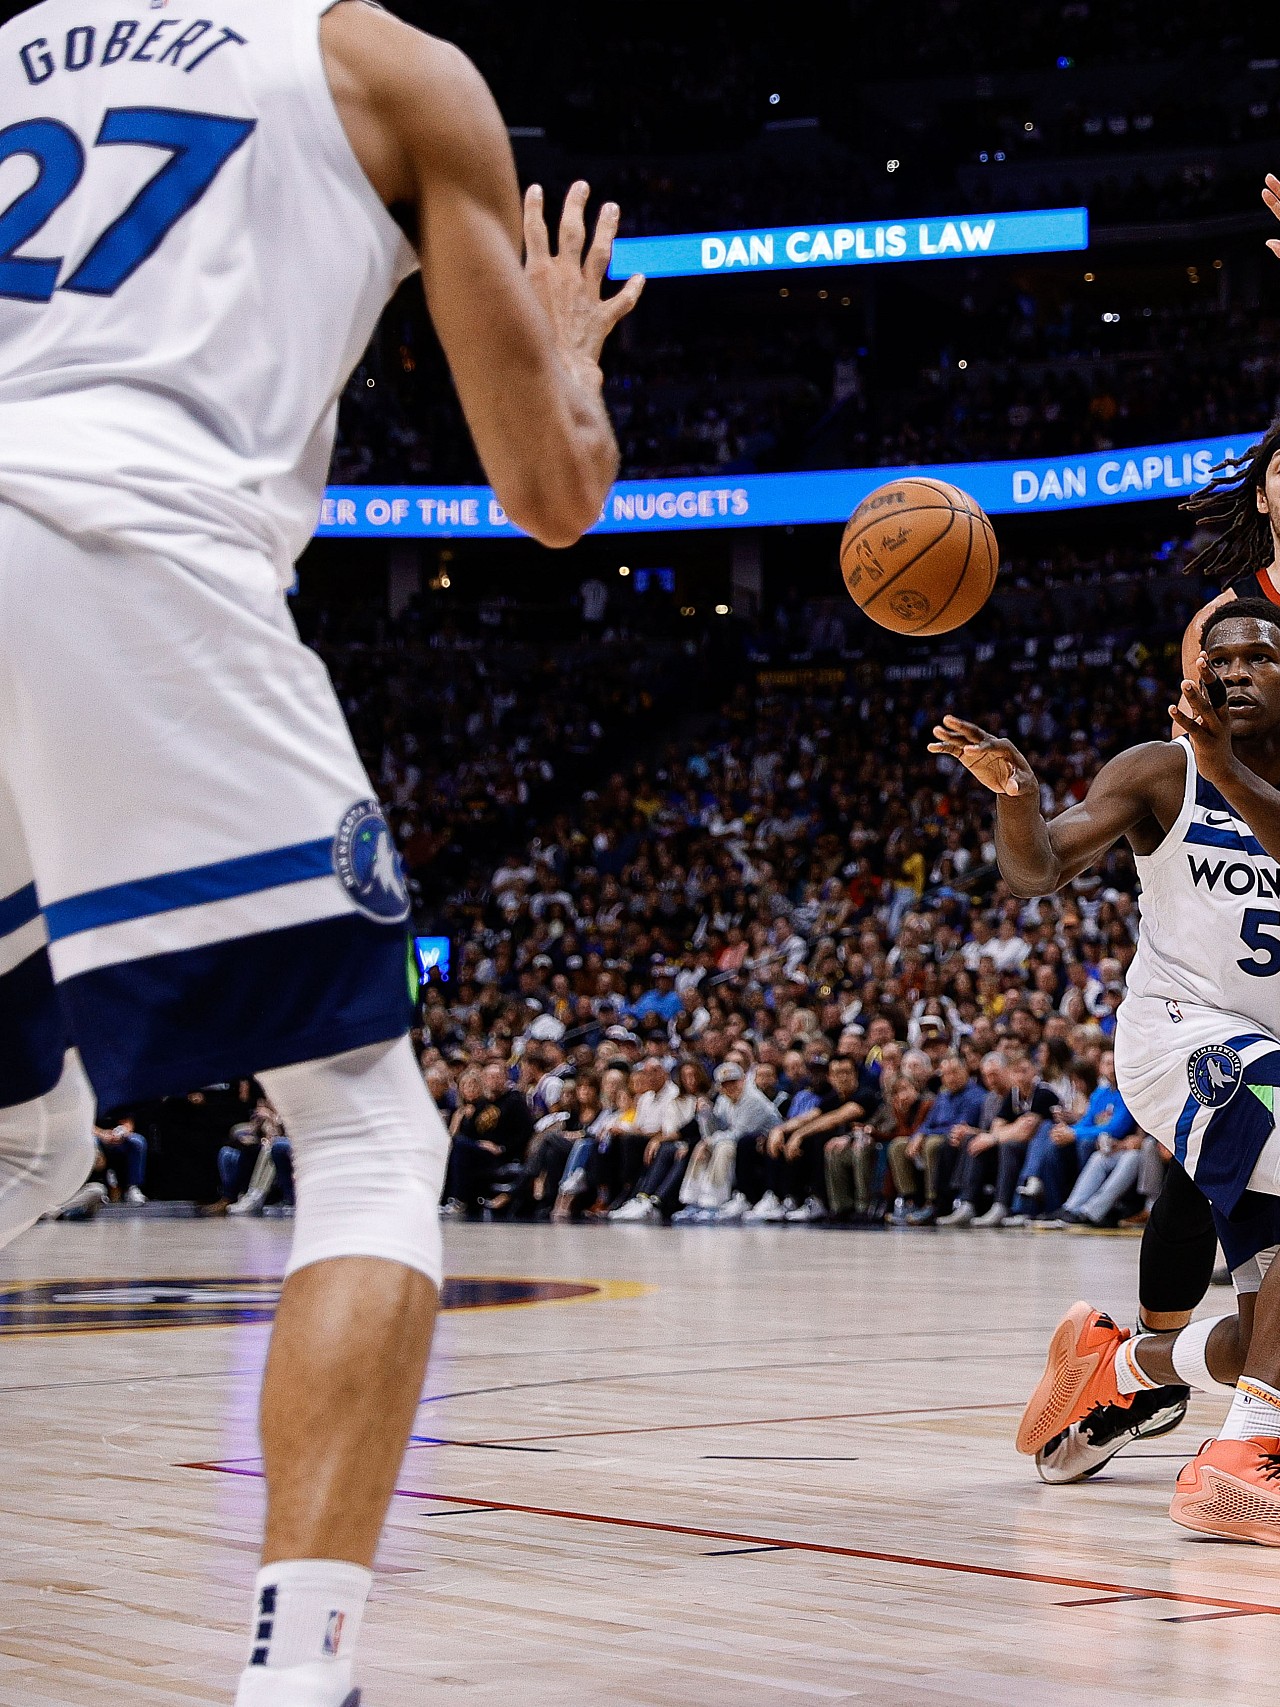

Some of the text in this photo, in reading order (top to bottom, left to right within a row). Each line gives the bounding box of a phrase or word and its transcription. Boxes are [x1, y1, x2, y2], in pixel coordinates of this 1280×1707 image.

[19, 19, 249, 86] GOBERT
[0, 105, 258, 304] 27
[701, 219, 996, 269] DAN CAPLIS LAW
[1013, 467, 1086, 503] DAN
[1097, 449, 1214, 495] CAPLIS
[365, 498, 410, 526] OF
[416, 498, 479, 526] THE
[614, 488, 748, 521] NUGGETS
[1192, 1045, 1241, 1072] TIMBERWOLVES
